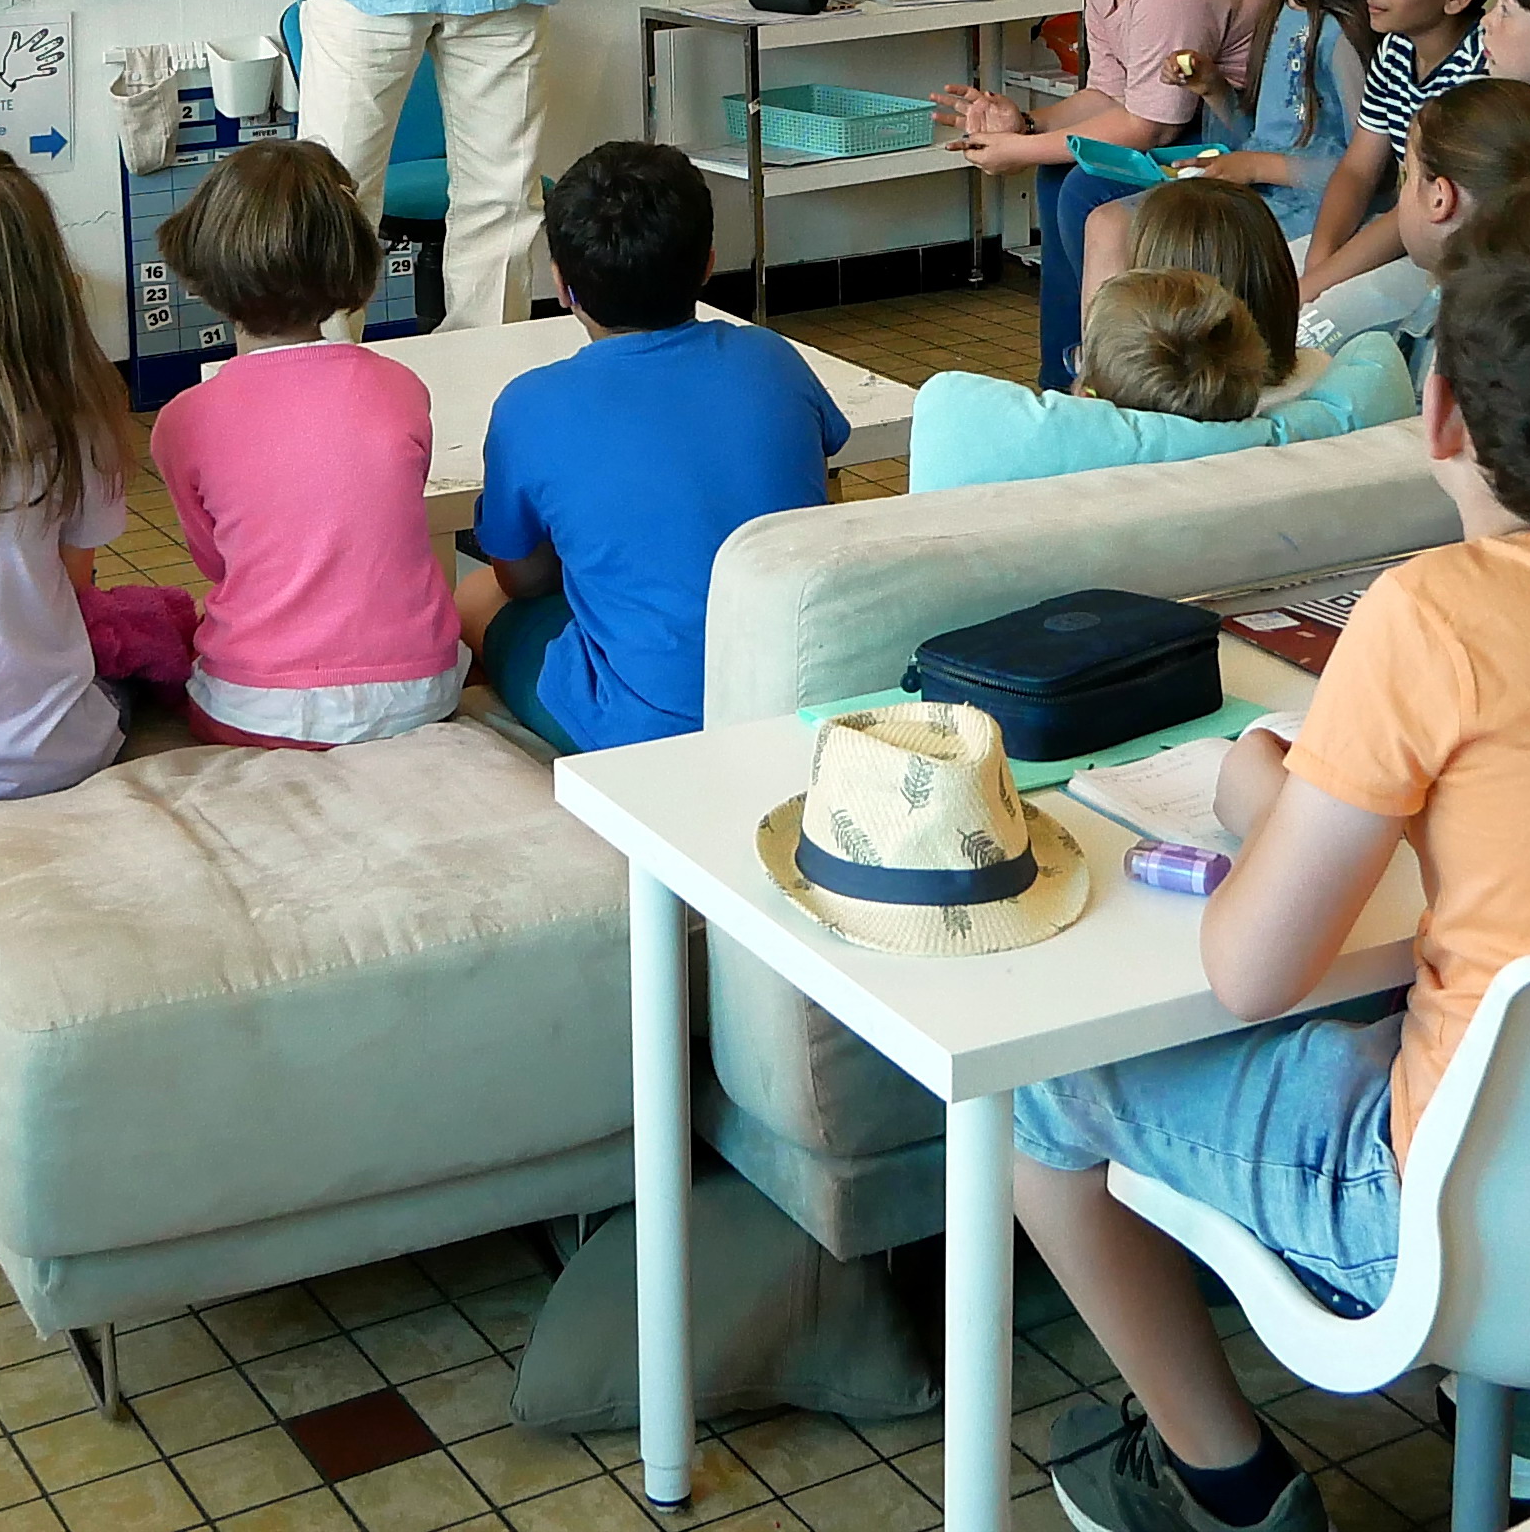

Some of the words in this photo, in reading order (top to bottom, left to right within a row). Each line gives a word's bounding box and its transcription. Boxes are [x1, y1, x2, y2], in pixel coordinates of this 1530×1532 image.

[182, 106, 192, 119] 2
[145, 266, 163, 279] 16
[391, 260, 411, 273] 29
[146, 288, 167, 301] 23
[148, 309, 169, 326] 30
[202, 329, 221, 344] 31
